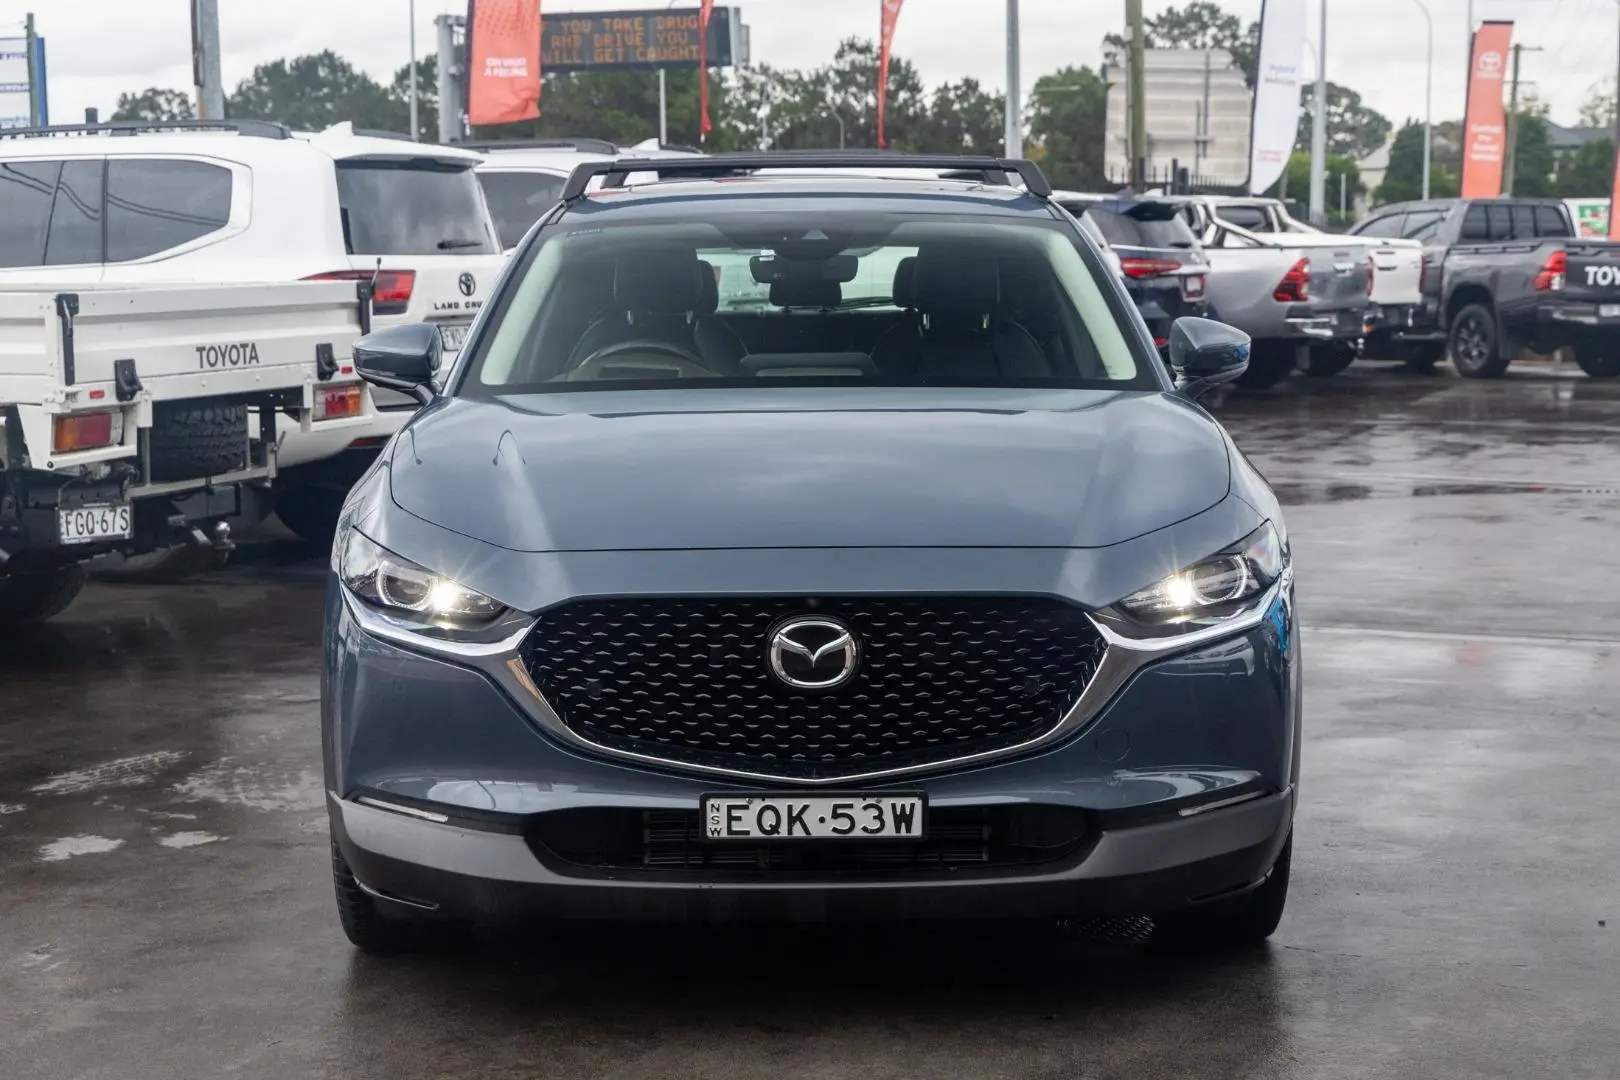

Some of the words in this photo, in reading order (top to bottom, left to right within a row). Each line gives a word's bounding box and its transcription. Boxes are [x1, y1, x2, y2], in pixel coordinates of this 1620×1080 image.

[561, 19, 592, 33] YOU
[603, 17, 645, 31] TAKE
[655, 15, 698, 29] DRUG
[593, 32, 645, 48] DRIVE
[656, 30, 688, 45] YOU
[594, 48, 624, 63] GET
[636, 45, 698, 61] CAUGHT
[434, 301, 460, 310] LAND
[195, 342, 260, 369] TOYOTA
